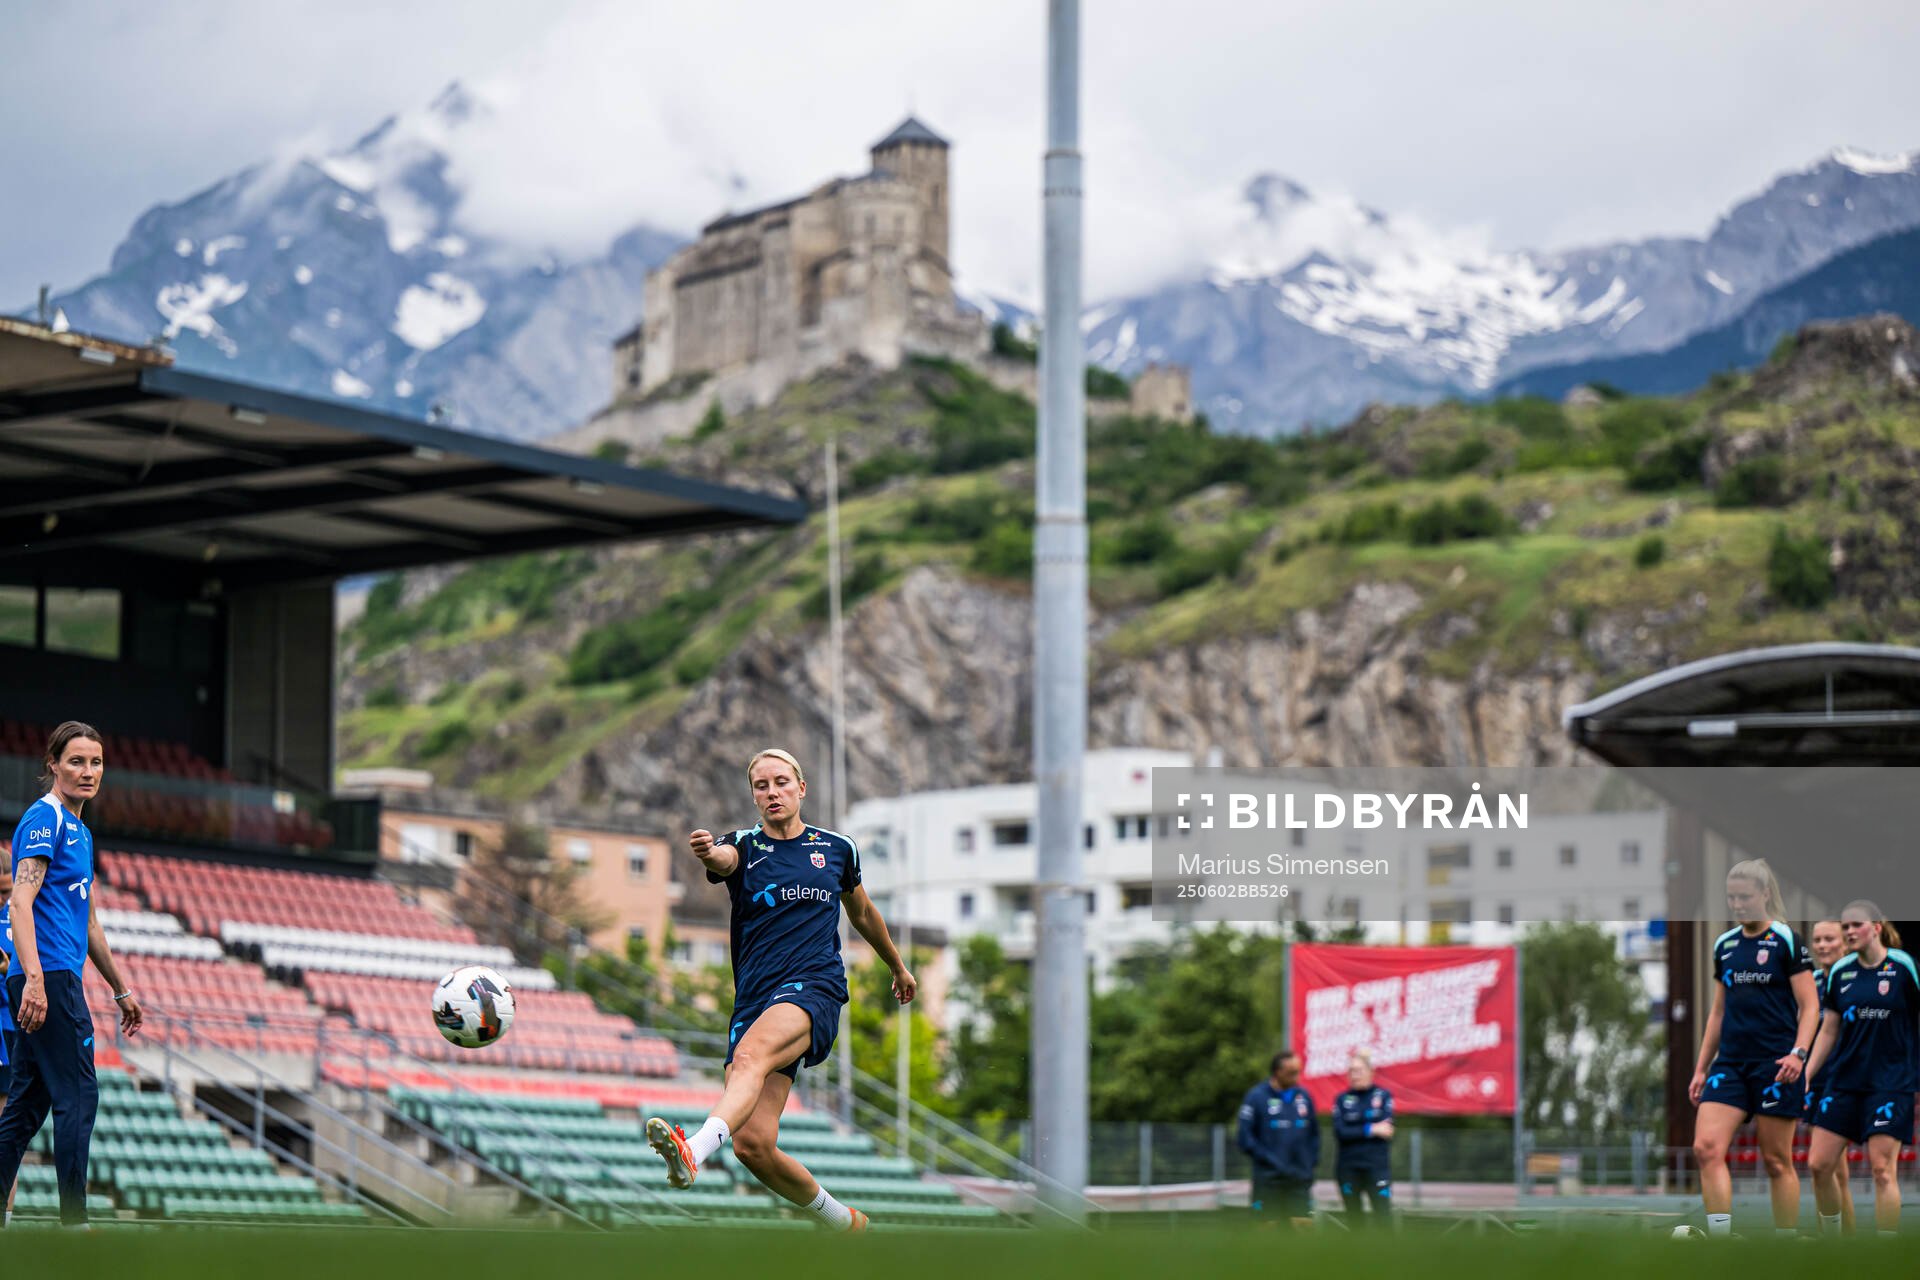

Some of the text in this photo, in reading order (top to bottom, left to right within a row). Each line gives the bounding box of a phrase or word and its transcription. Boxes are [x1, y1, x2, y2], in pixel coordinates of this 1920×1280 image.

[30, 827, 52, 841] DNB
[780, 884, 832, 903] telenor
[1733, 970, 1772, 984] telenor
